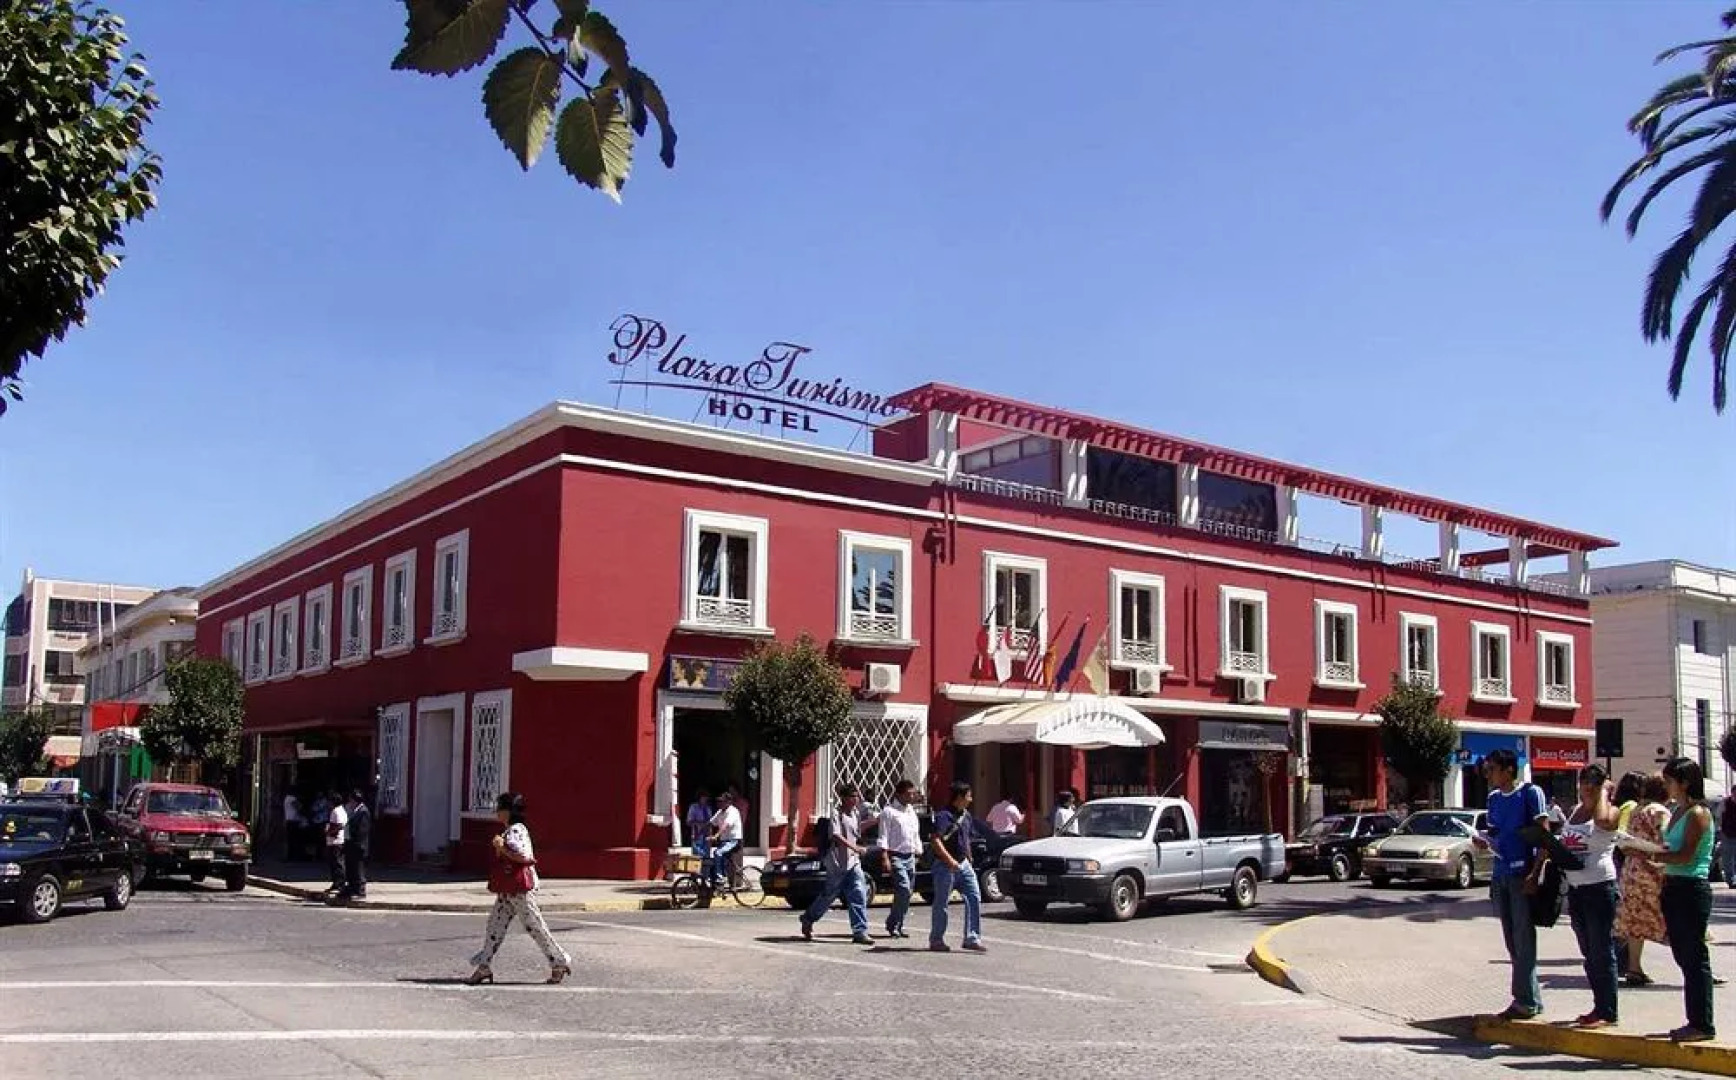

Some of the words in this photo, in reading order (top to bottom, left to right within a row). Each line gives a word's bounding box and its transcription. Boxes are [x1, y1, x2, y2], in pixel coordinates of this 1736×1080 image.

[607, 313, 742, 386] Plaza
[743, 341, 903, 417] Turismo
[708, 397, 819, 433] HOTEL
